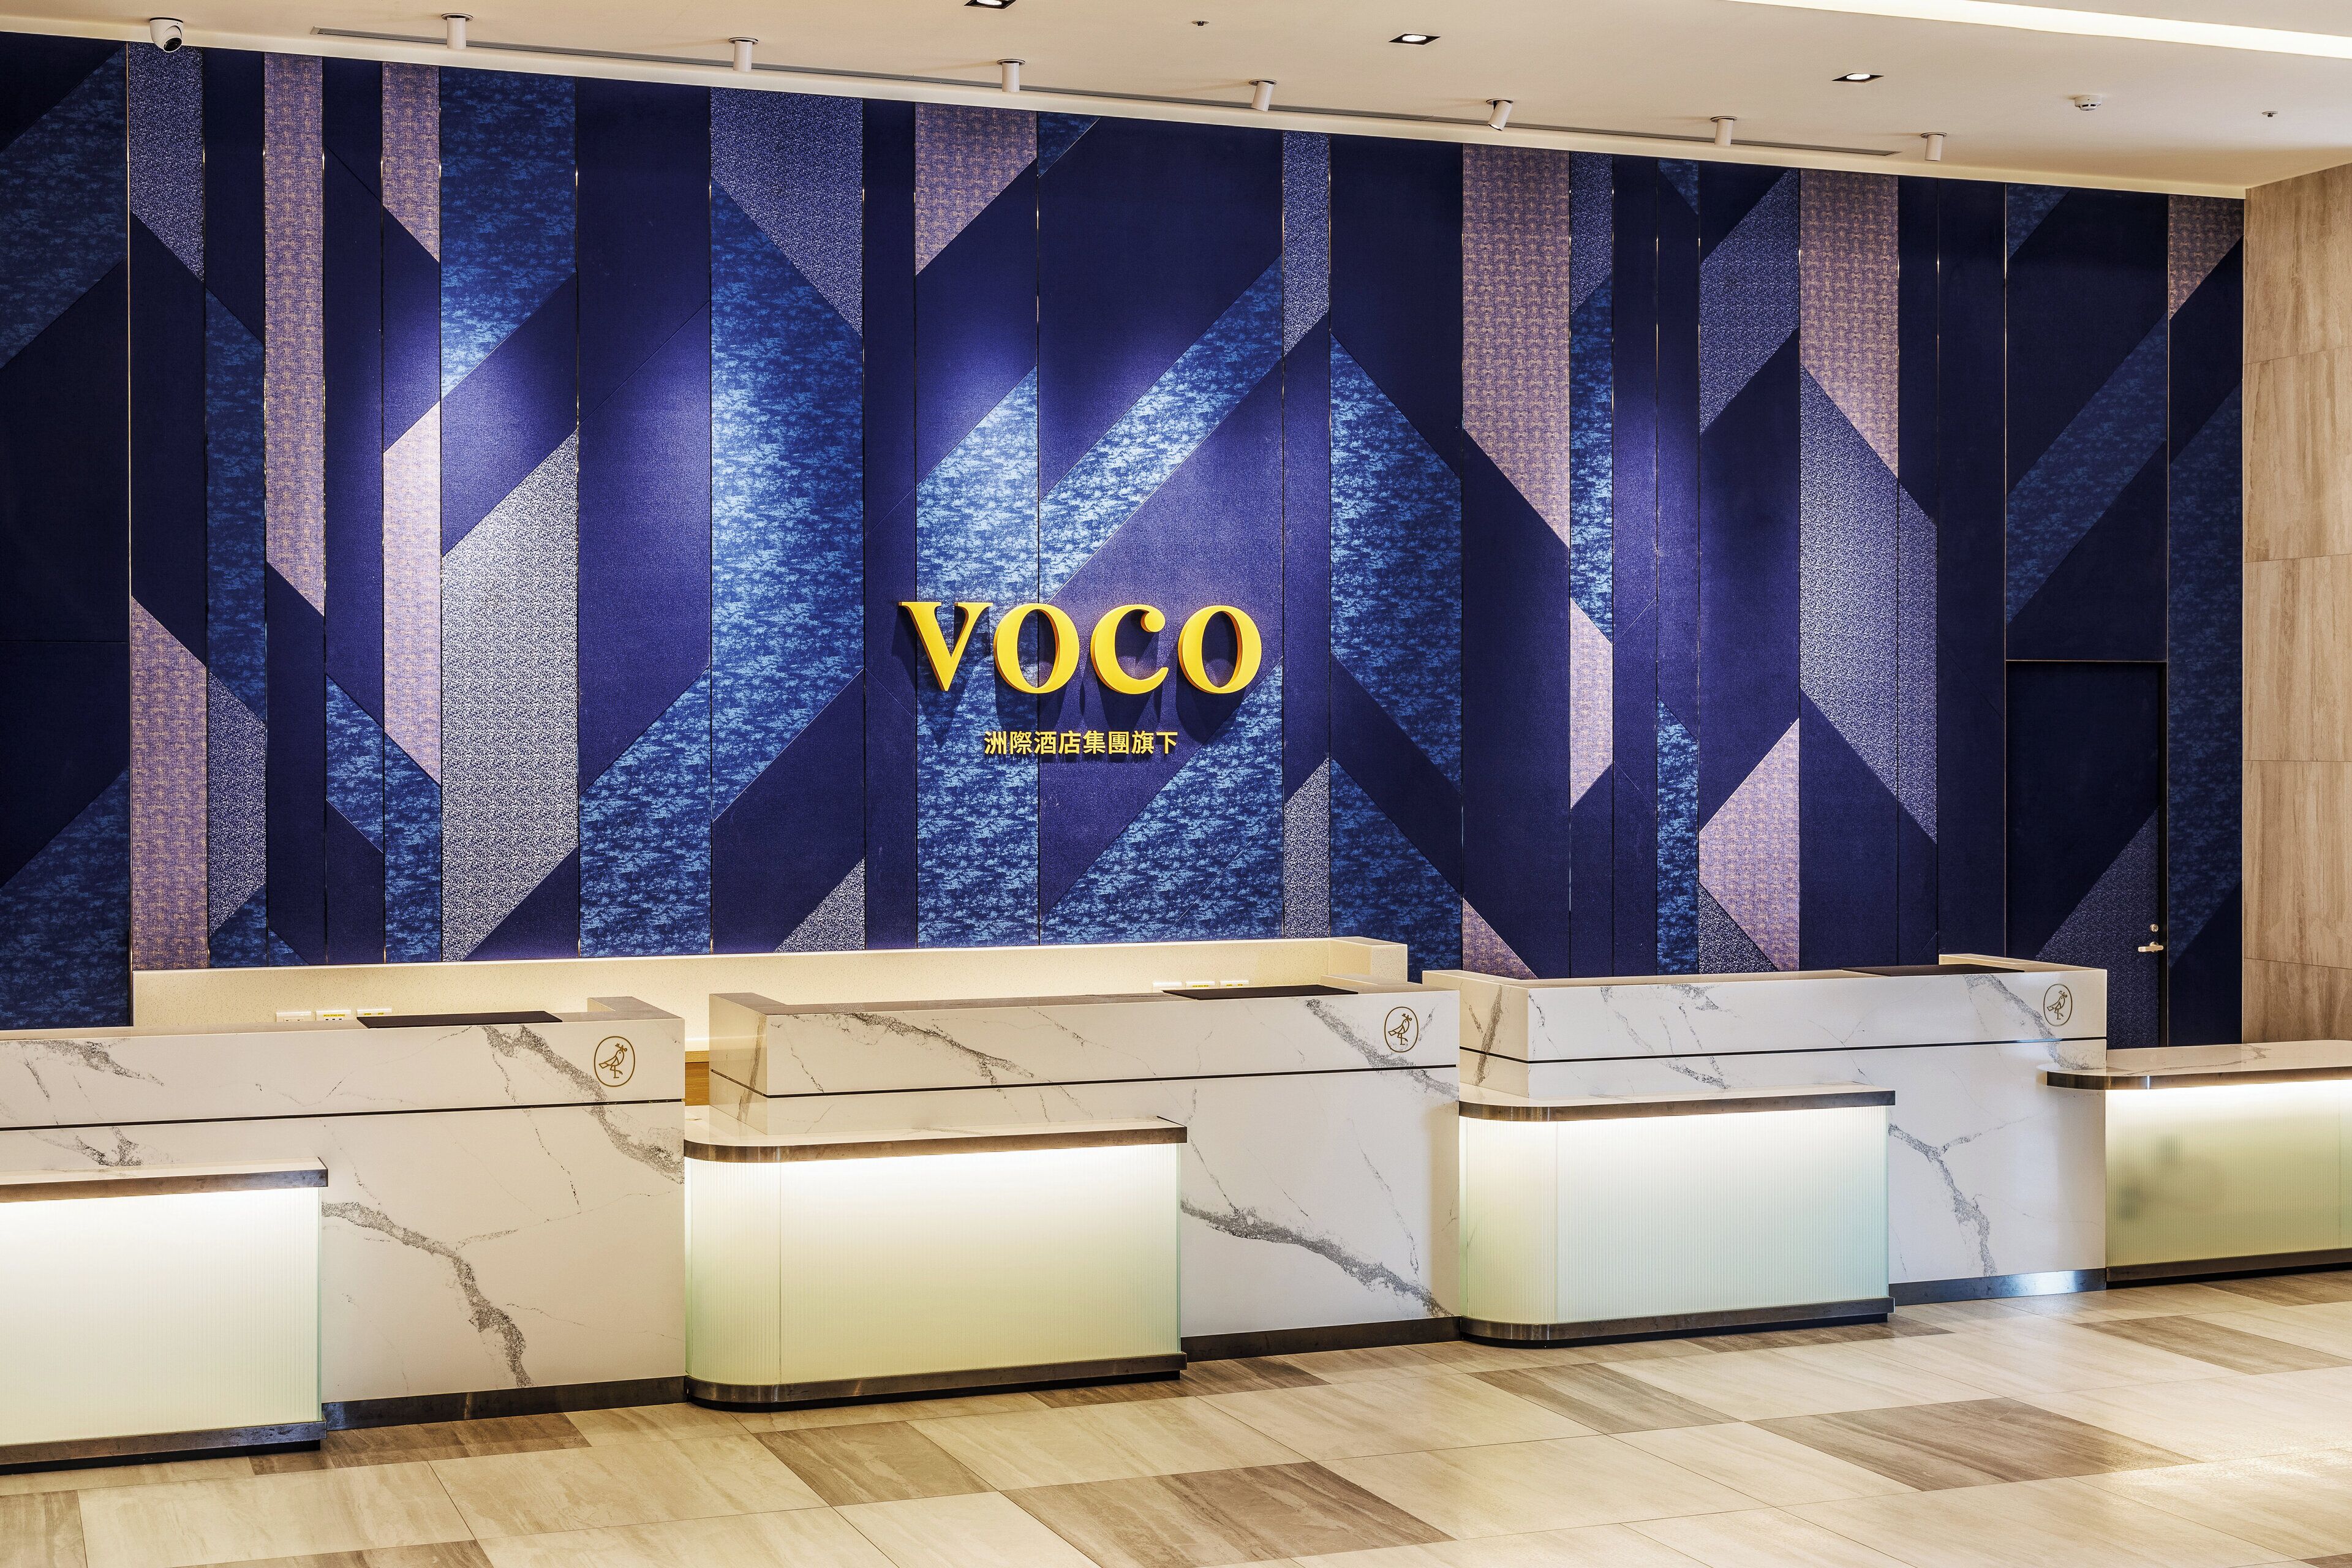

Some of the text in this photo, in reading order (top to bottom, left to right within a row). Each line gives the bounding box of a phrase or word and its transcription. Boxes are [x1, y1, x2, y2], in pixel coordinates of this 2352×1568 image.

[984, 730, 1178, 755] 洲際酒店集團旗下
